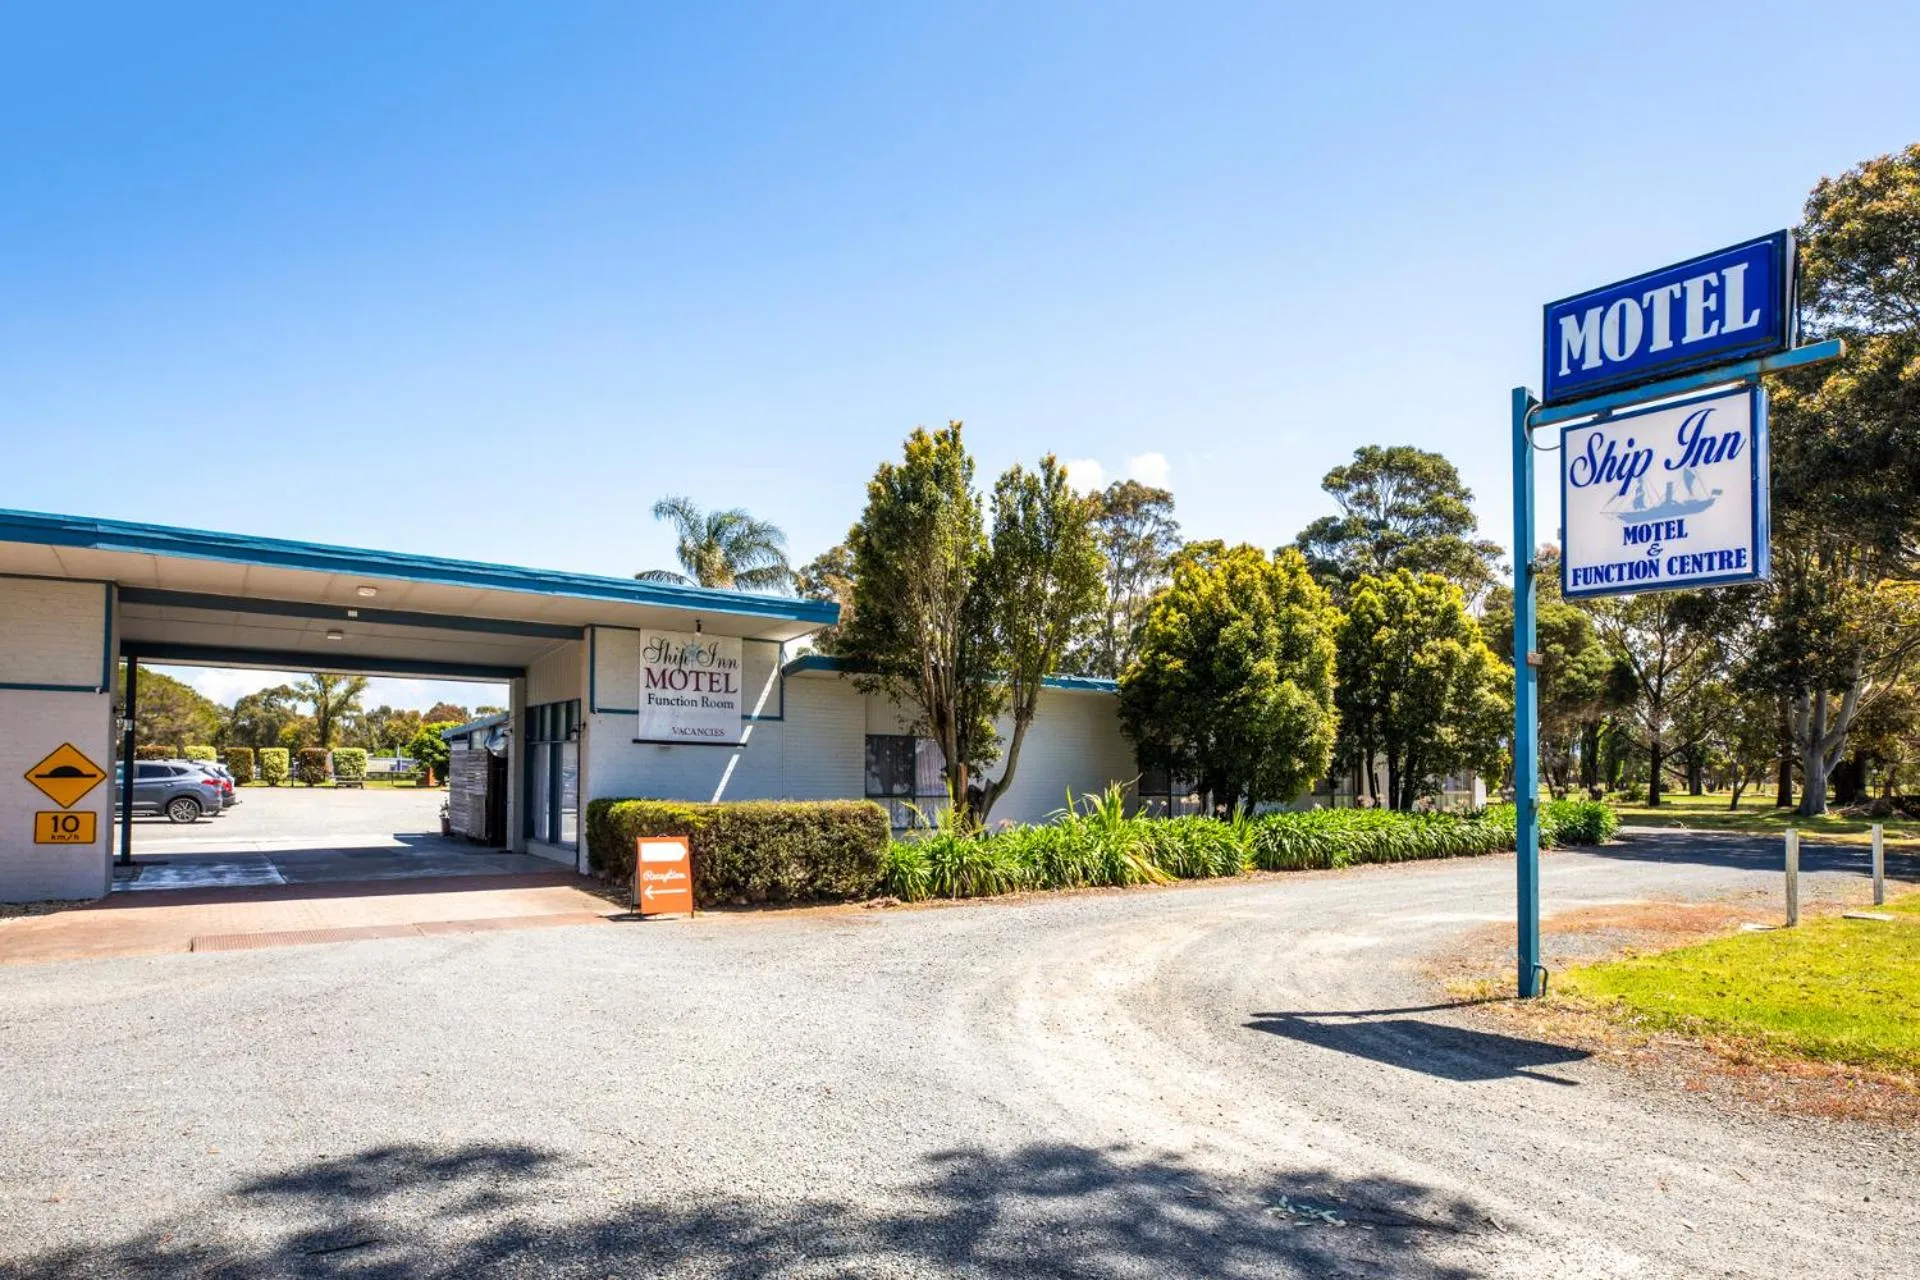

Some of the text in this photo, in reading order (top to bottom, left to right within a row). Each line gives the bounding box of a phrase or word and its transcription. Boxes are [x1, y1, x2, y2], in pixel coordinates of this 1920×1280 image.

[1558, 262, 1761, 377] MOTEL
[1569, 408, 1747, 496] Ship Inn
[1622, 518, 1688, 546] MOTEL
[1646, 543, 1663, 556] &
[1571, 547, 1747, 587] FUNCTION CENTRE
[643, 636, 738, 674] Ship Inn
[644, 667, 738, 694] MOTEL
[647, 692, 735, 710] Function Room
[672, 726, 726, 737] VACANCIES
[51, 815, 80, 833] 10
